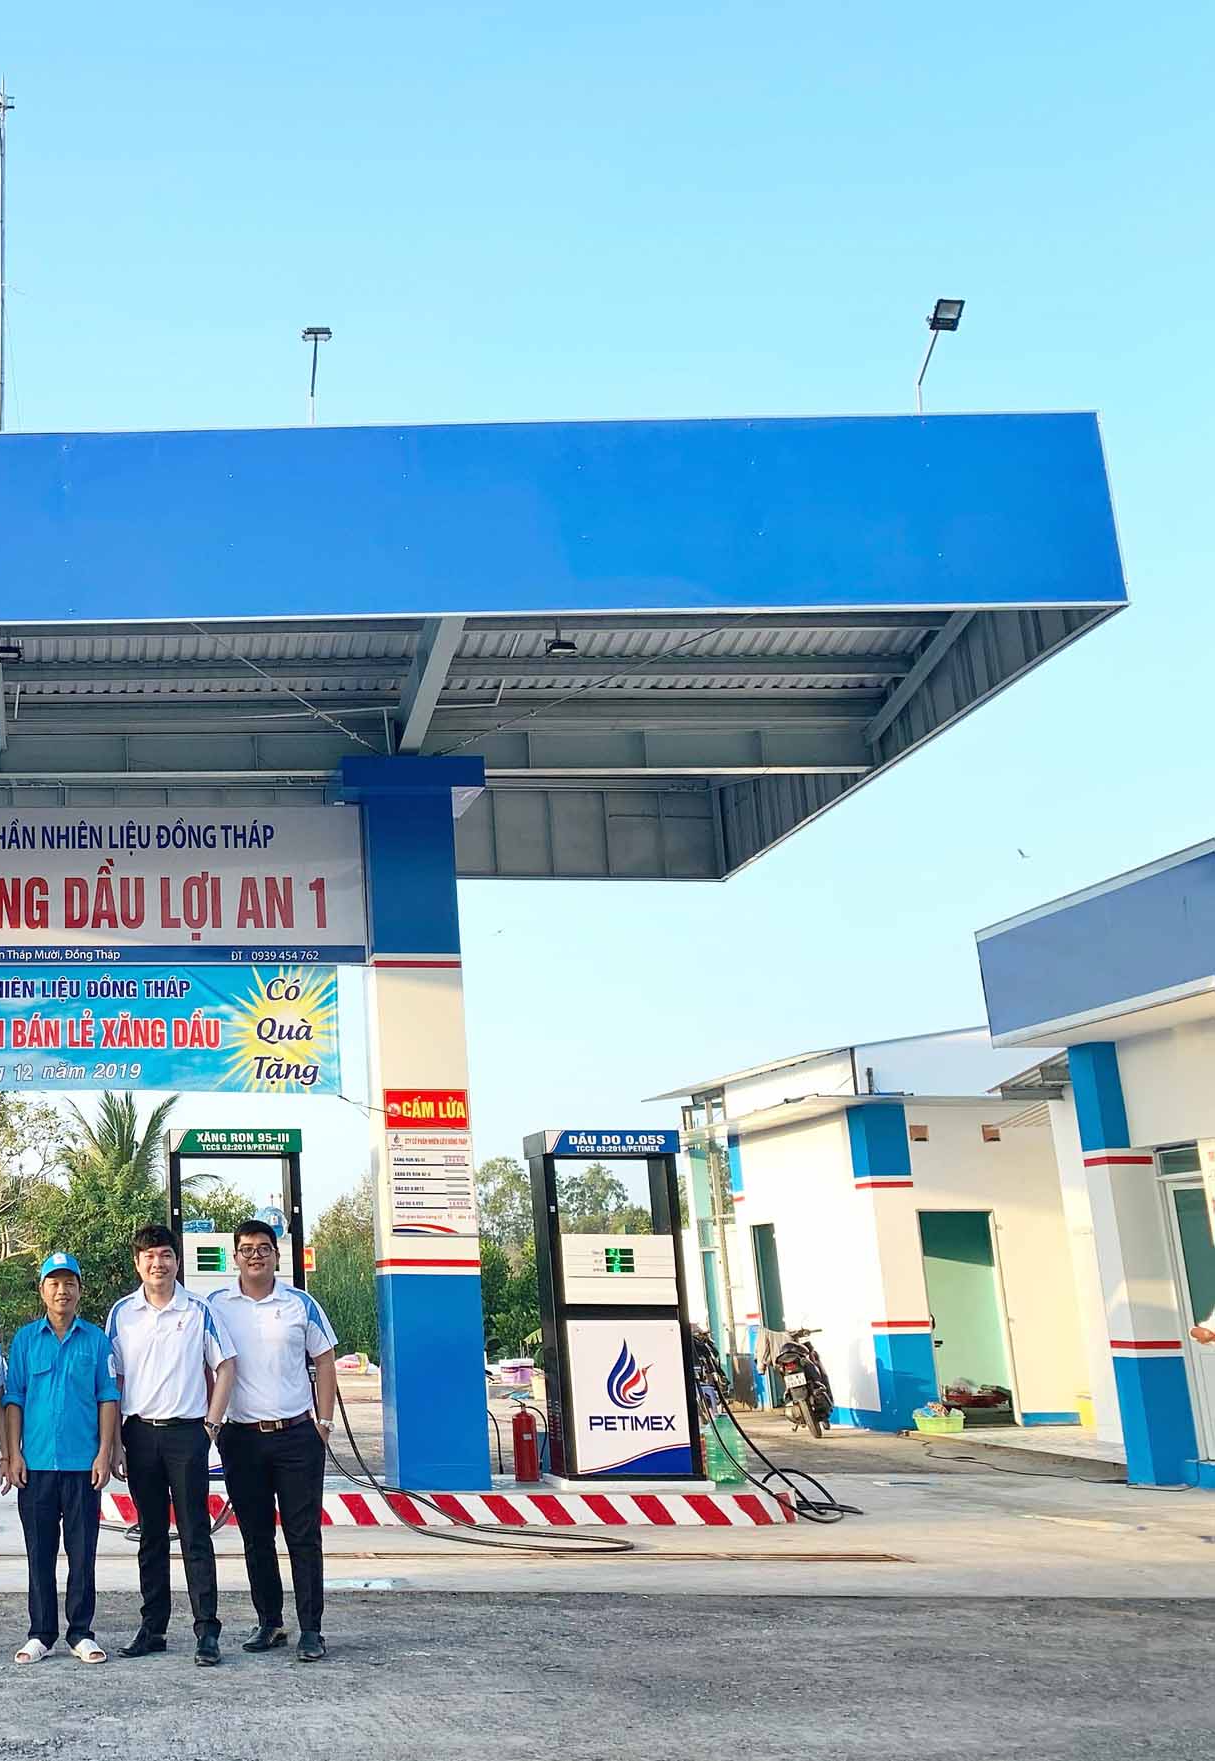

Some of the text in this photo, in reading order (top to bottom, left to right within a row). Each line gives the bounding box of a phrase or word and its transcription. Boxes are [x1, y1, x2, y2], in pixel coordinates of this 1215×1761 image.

[41, 820, 103, 849] NHIÊN
[108, 820, 151, 856] LIỆU
[156, 817, 217, 849] ĐỒNG
[220, 819, 274, 849] THÁP
[64, 858, 145, 929] DẦU
[160, 871, 222, 941] LỢI
[236, 876, 295, 929] AN
[308, 876, 327, 929] 1
[7, 950, 32, 962] Tháp
[65, 949, 93, 963] Đồng
[96, 949, 121, 961] Tháp
[251, 950, 277, 961] 0939
[278, 950, 298, 961] 454
[300, 950, 319, 961] 762
[40, 976, 81, 1003] LIỆU
[86, 974, 137, 998] ĐỒNG
[144, 976, 191, 998] THÁP
[265, 977, 302, 1002] Có
[12, 1012, 61, 1050] BÁN
[66, 1009, 94, 1050] LẺ
[100, 1012, 167, 1050] XĂNG
[172, 1008, 222, 1049] DẦU
[255, 1016, 315, 1045] Quà
[13, 1063, 33, 1082] 12
[41, 1062, 85, 1080] năm
[92, 1062, 143, 1080] 2019
[252, 1056, 321, 1087] Tặng
[401, 1095, 466, 1119] CẤM LỬA
[196, 1131, 290, 1143] XĂNG RON 95-III
[202, 1143, 220, 1151] TCCS
[601, 1135, 621, 1145] DO
[625, 1135, 666, 1145] 0.05S
[576, 1145, 595, 1153] TCCS
[588, 1414, 677, 1431] PETIMEX
